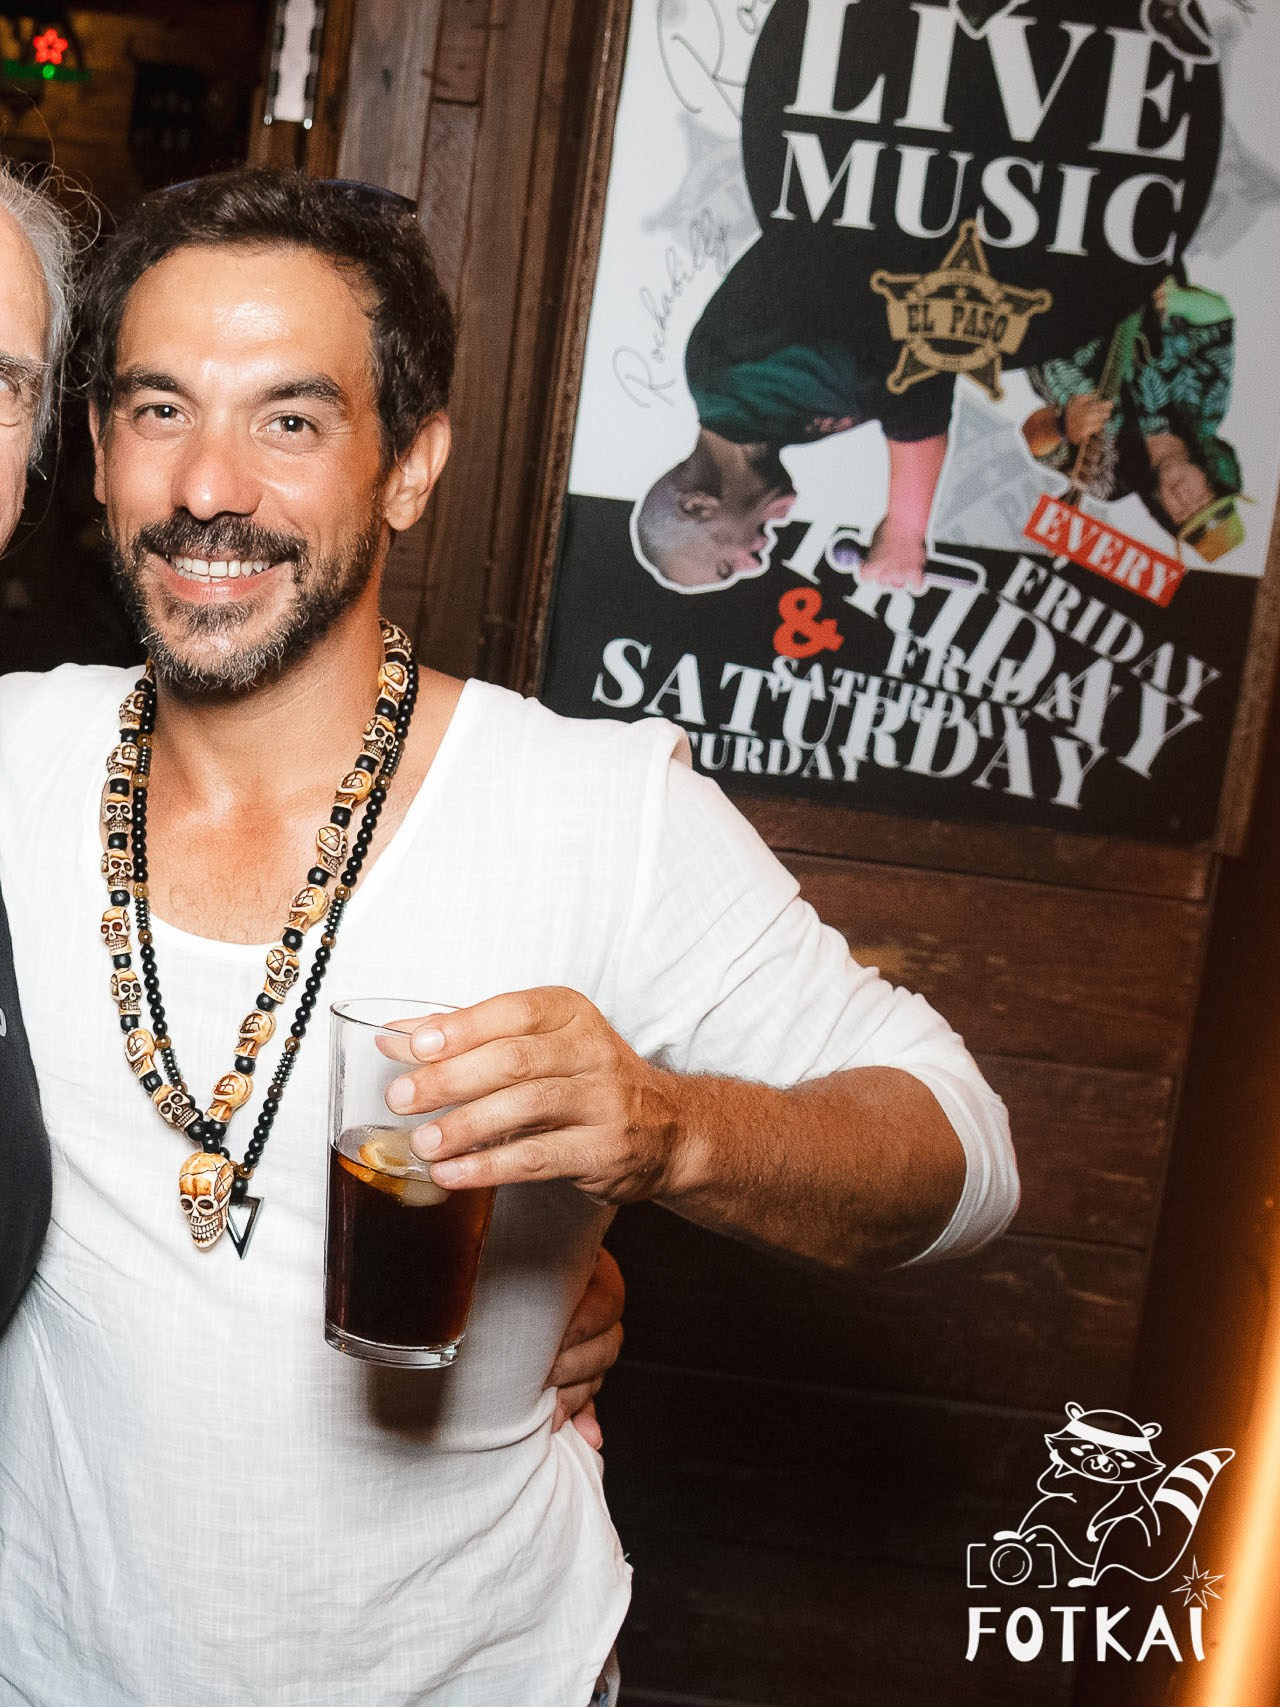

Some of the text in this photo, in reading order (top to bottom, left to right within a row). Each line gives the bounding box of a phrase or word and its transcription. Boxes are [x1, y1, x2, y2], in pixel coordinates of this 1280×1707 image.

[783, 0, 1193, 161] LIVE
[770, 130, 1186, 266] MUSIC
[906, 303, 1009, 344] EL PASO
[1033, 501, 1180, 602] EVERY
[773, 586, 845, 660] &
[999, 554, 1221, 707] FRIDAY
[592, 637, 1108, 810] SATURDAY
[687, 730, 869, 782] URDAY
